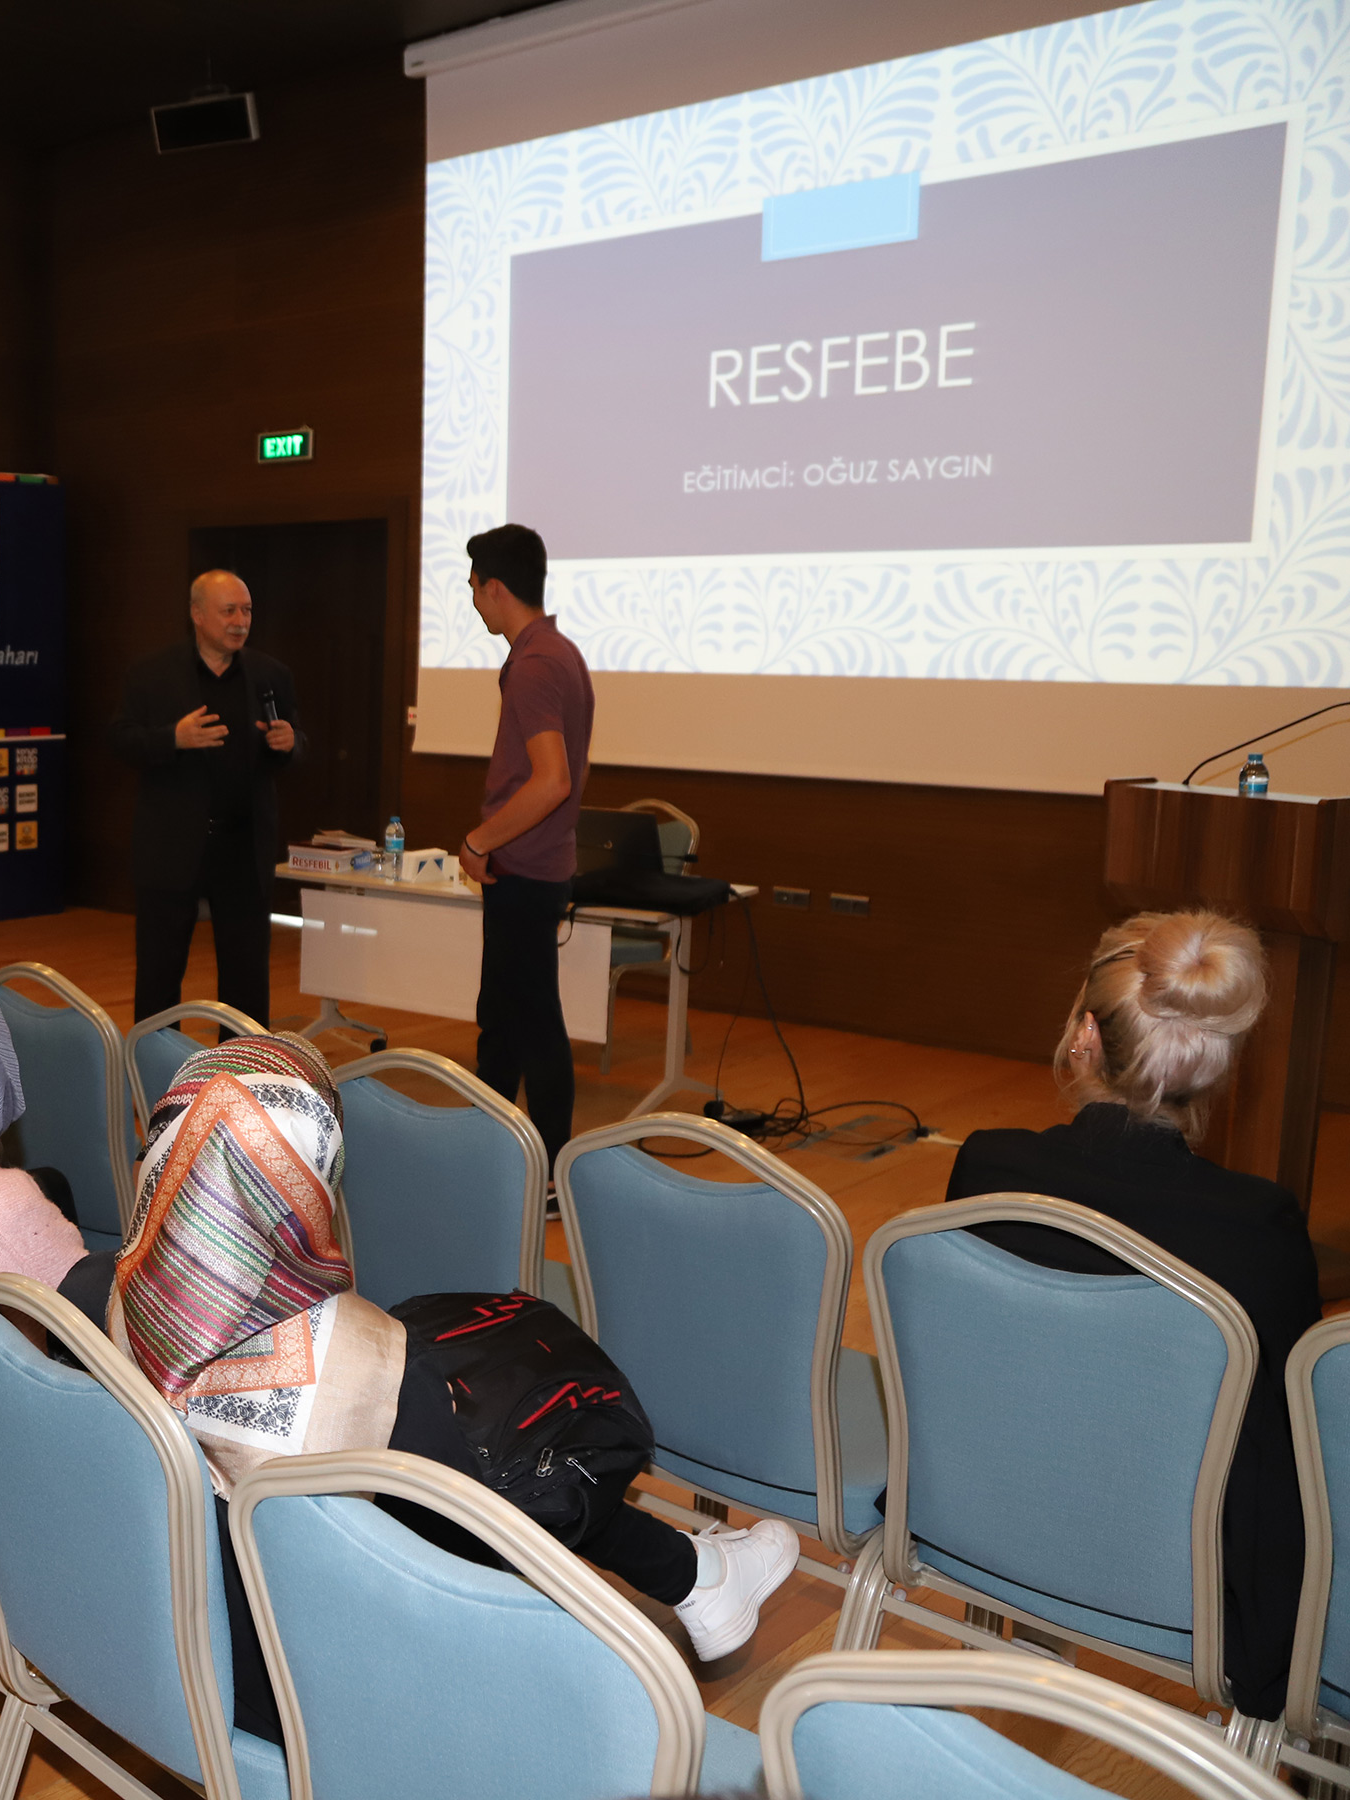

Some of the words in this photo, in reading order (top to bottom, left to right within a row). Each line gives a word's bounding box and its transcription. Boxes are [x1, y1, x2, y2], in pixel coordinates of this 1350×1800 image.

[709, 322, 977, 408] RESFEBE
[264, 434, 303, 458] EXIT
[683, 461, 795, 493] EĞİTİMCİ:
[803, 456, 879, 487] OĞUZ
[887, 454, 993, 482] SAYGIN
